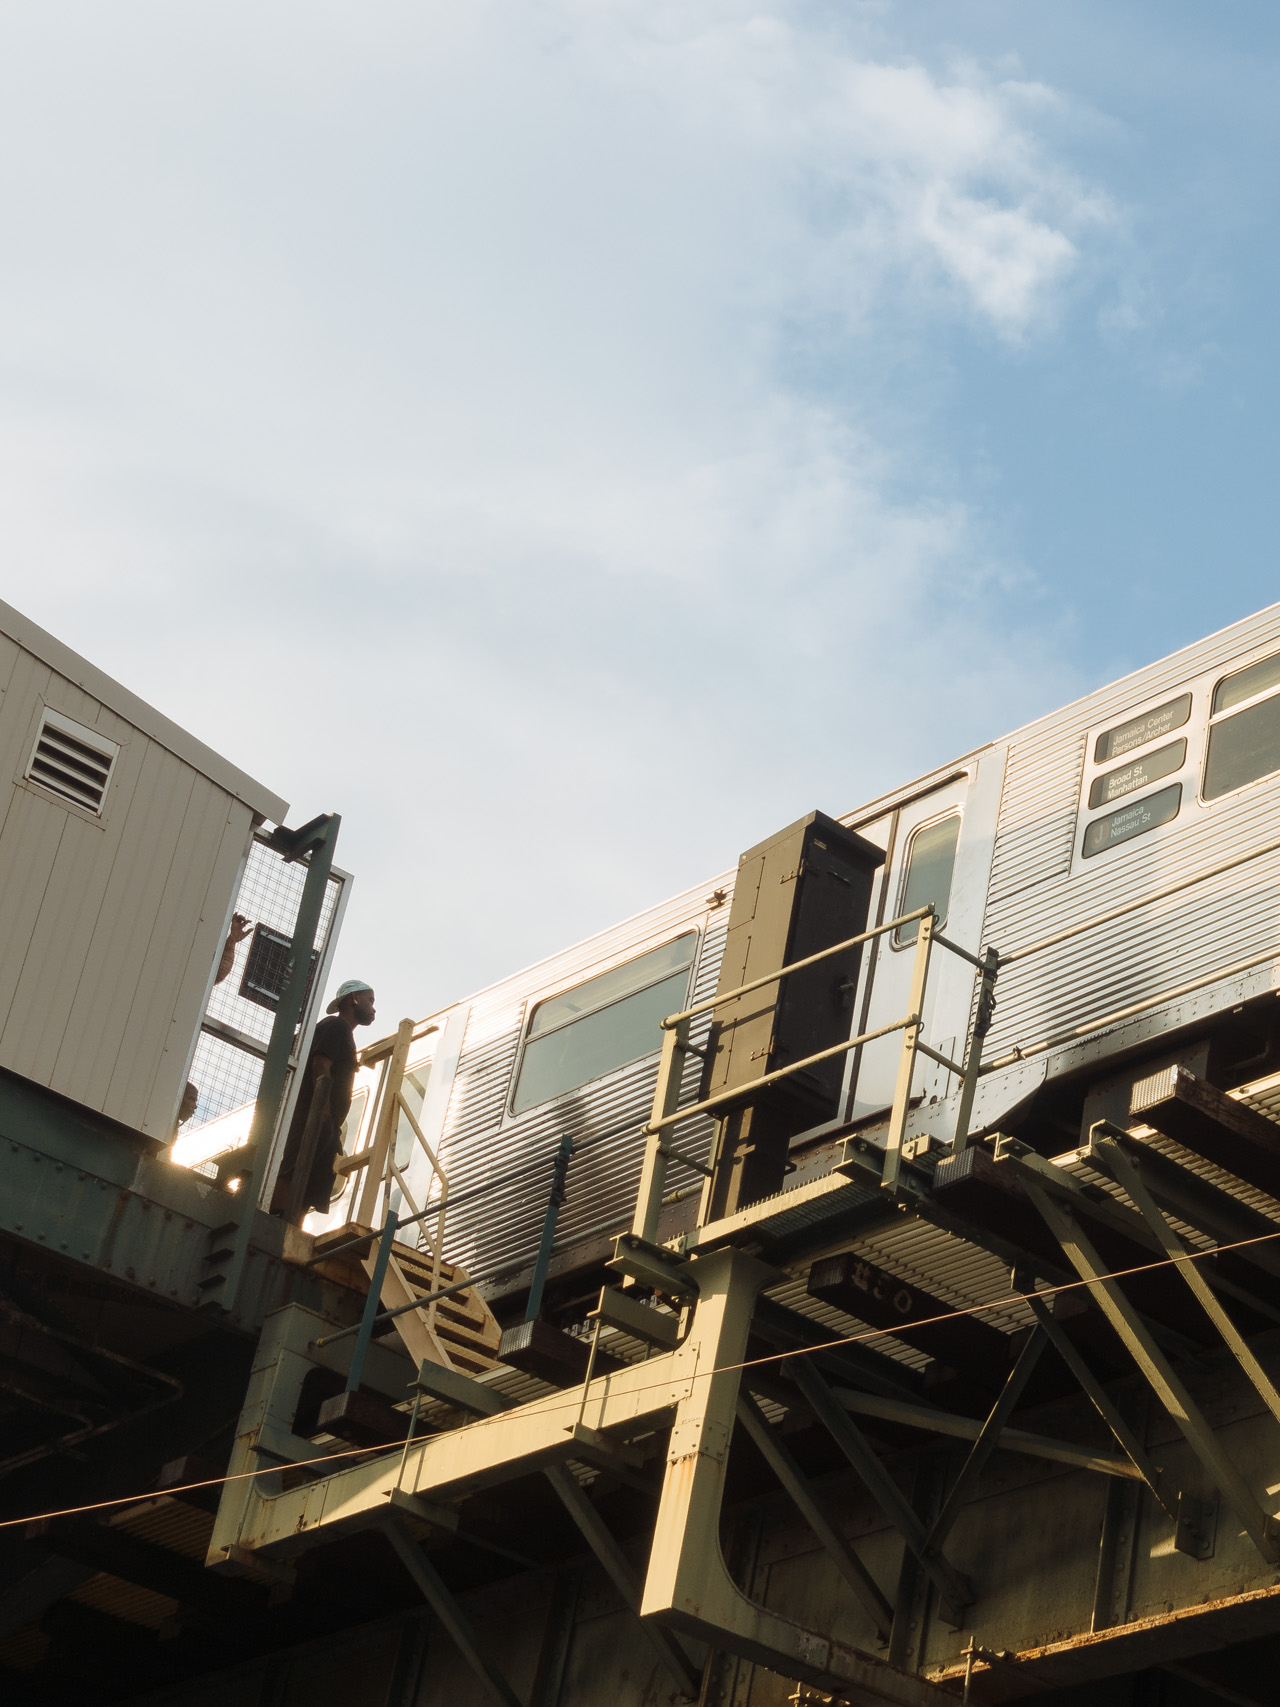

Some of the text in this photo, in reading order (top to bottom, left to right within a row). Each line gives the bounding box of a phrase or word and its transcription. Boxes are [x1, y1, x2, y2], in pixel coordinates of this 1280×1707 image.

[1111, 723, 1172, 757] Parsons/Archer
[1113, 711, 1174, 746] Jamaica Center
[1108, 765, 1143, 789] Broad St
[1108, 775, 1148, 799] Manhattan
[1110, 812, 1151, 839] Nassau St
[1111, 806, 1144, 827] Jamaica
[1094, 824, 1104, 844] J
